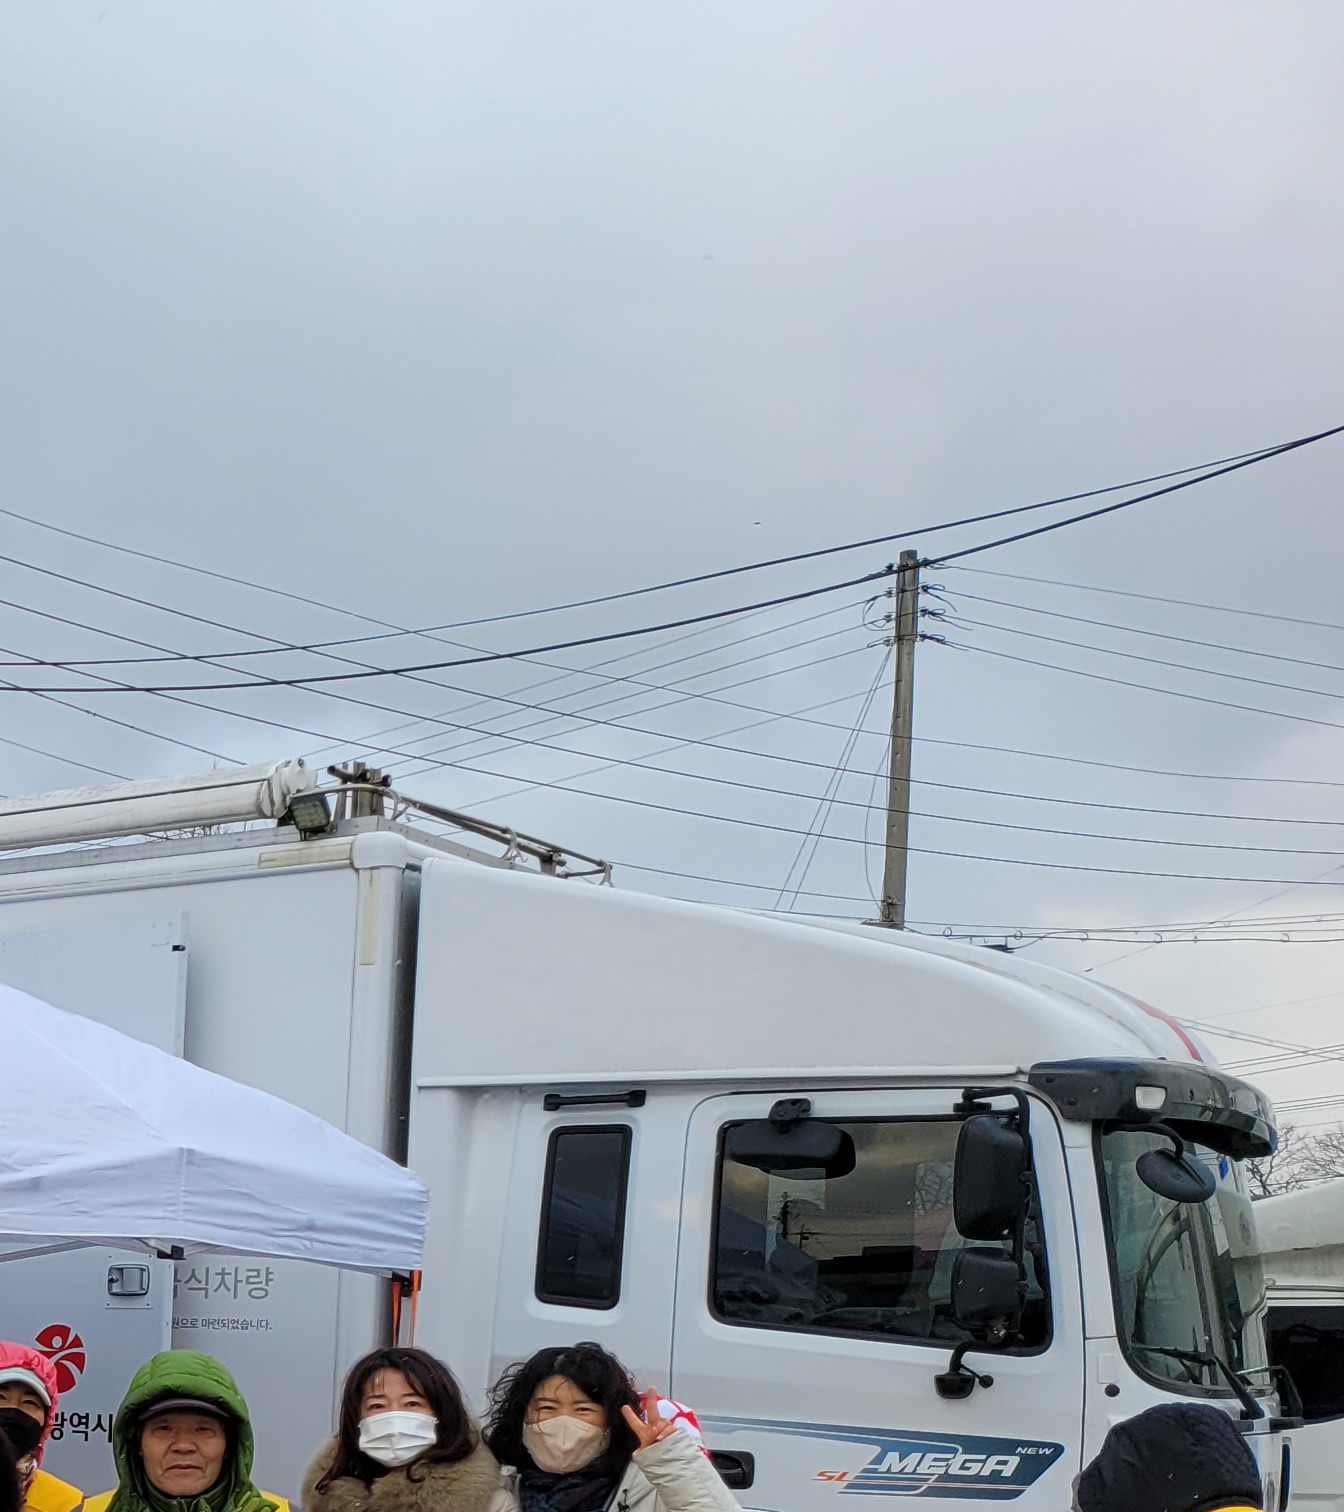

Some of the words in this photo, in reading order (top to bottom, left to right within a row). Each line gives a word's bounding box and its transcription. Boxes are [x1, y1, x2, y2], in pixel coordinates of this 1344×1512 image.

[201, 1318, 272, 1330] 마련되었습니다.
[1015, 1446, 1054, 1455] NEW
[876, 1451, 1021, 1478] MEGA
[816, 1470, 852, 1482] SL
